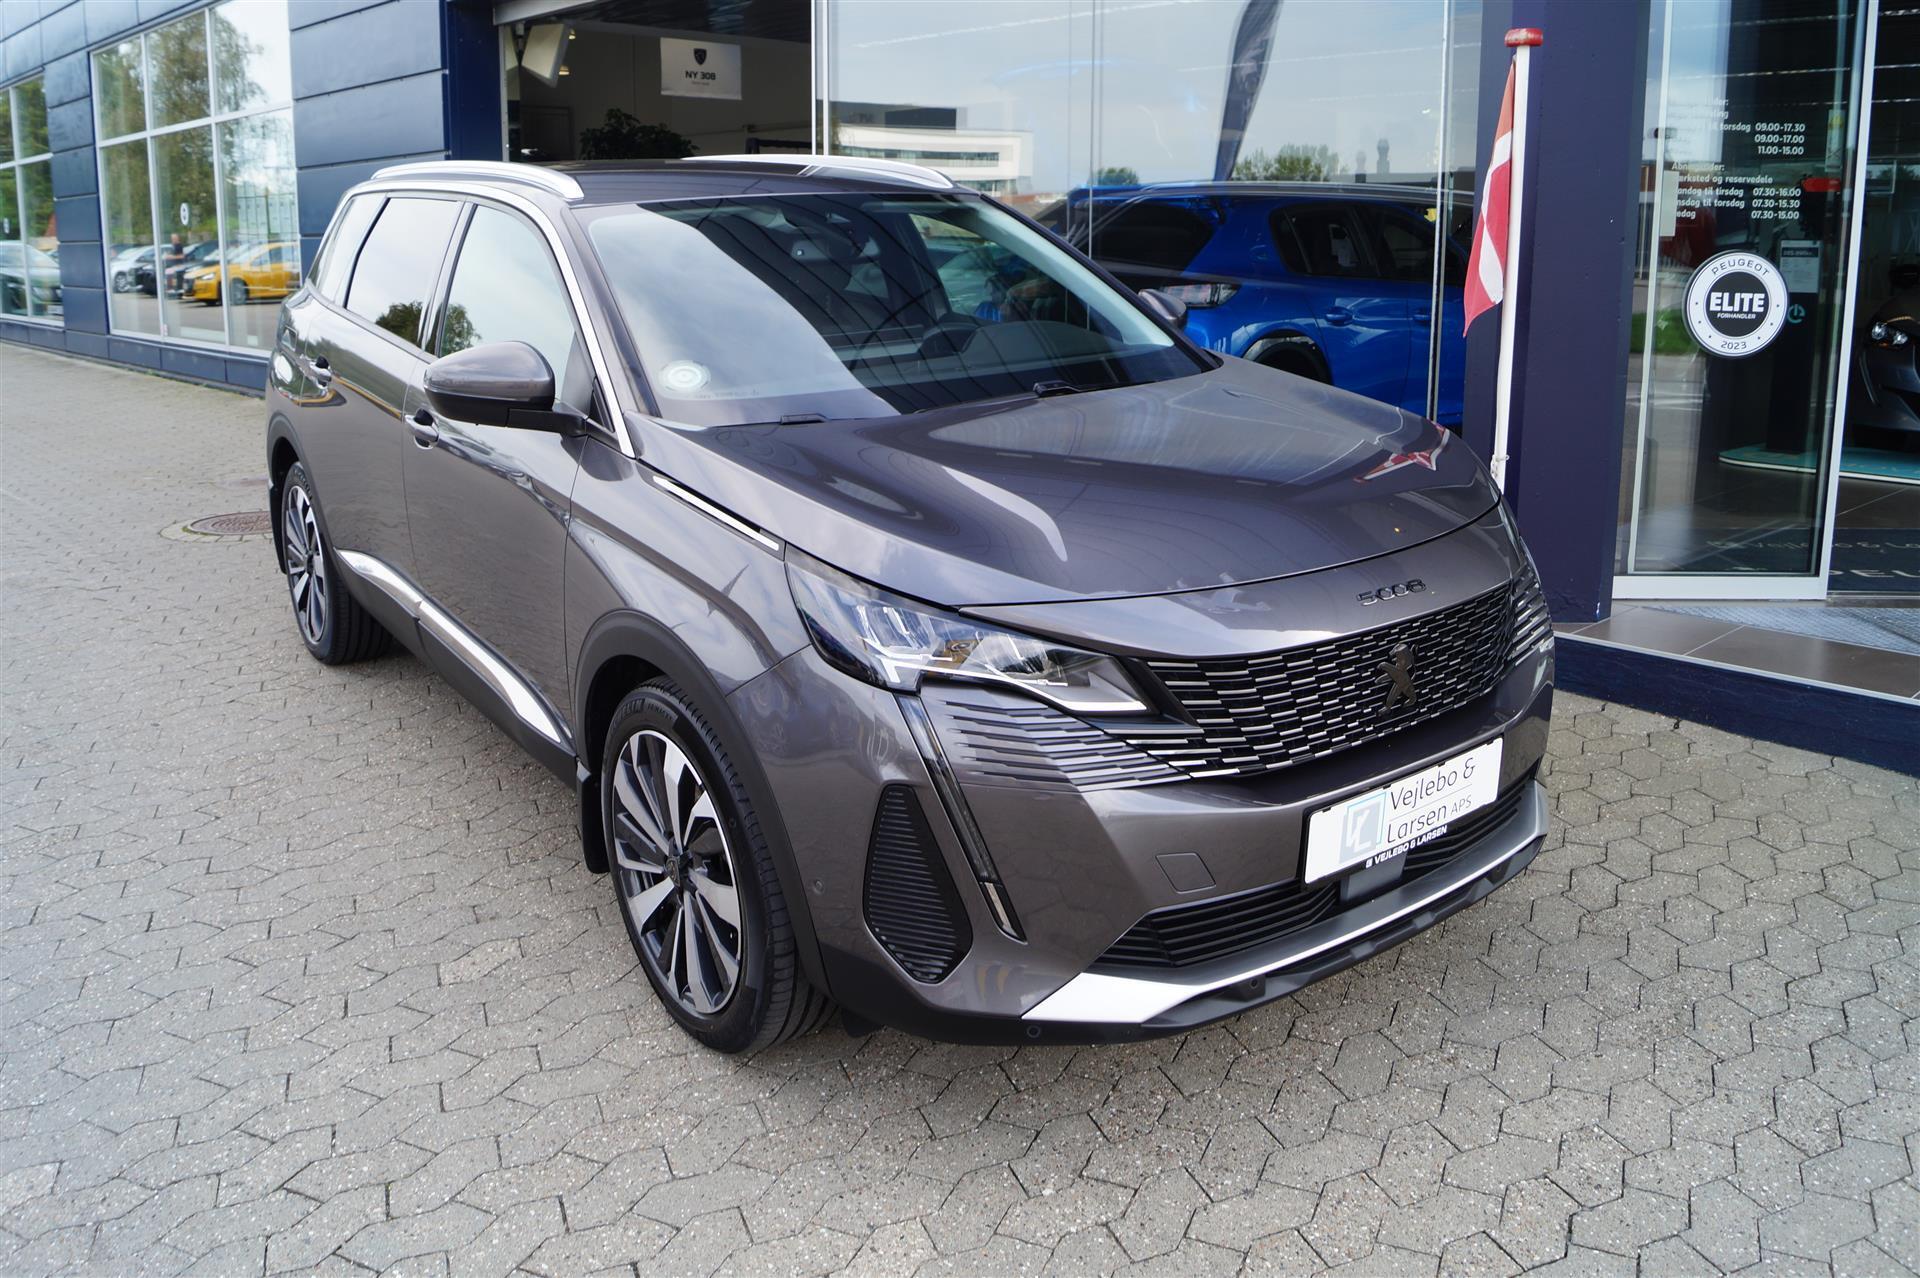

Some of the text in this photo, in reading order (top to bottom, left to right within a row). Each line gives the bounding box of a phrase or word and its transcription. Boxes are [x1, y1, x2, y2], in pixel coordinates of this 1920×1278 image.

[685, 70, 716, 80] NY 308
[1755, 122, 1805, 132] 09.00-17.30
[1754, 134, 1805, 144] 09.00-17.00
[1757, 146, 1804, 155] 11.00-15.00
[1712, 175, 1723, 185] og
[1725, 174, 1773, 184] reservedele
[1677, 186, 1801, 197] andag til tirsdag 07.30-16.00
[1677, 198, 1800, 209] nsdag til torsdag 07.30-15.30
[1676, 209, 1800, 220] edag 07.30-15.00
[1711, 258, 1770, 277] PEUGEOT
[1709, 291, 1765, 312] ELITE
[1720, 340, 1747, 350] 2023
[1357, 579, 1426, 606] 5008
[1390, 757, 1476, 810] Vejlebo &
[1386, 795, 1473, 844] Larsen APS
[1374, 842, 1410, 866] VEJLEBO
[1417, 824, 1448, 847] LARSEN
